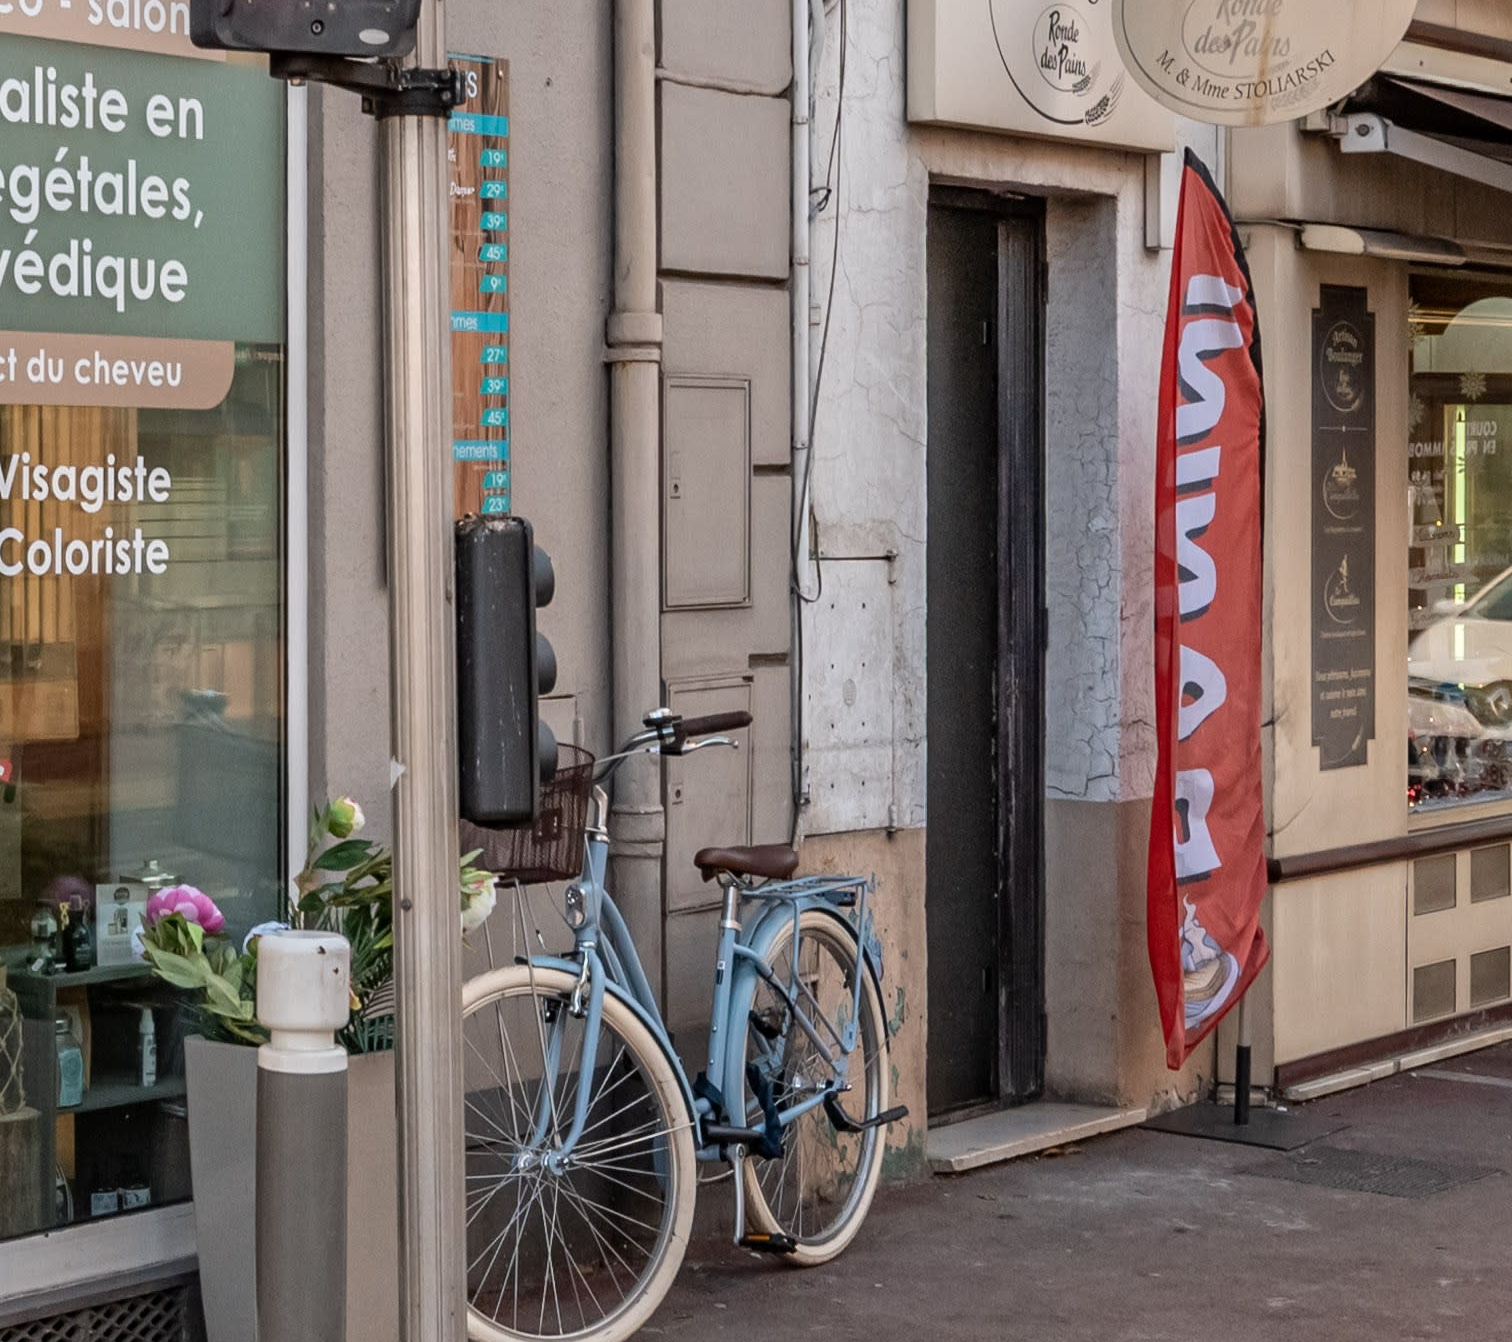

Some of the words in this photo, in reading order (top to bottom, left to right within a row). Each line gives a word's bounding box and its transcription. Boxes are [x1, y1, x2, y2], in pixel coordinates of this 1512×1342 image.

[1049, 10, 1080, 45] Ronde
[1194, 29, 1232, 56] des
[1228, 24, 1292, 65] Pains
[1040, 46, 1059, 72] des
[1056, 43, 1087, 80] Pains
[1176, 66, 1192, 86] &
[1191, 73, 1230, 100] Mme
[1233, 48, 1337, 100] STOLIARSKI
[146, 93, 205, 140] en
[27, 348, 63, 383] du
[75, 348, 182, 387] cheveu
